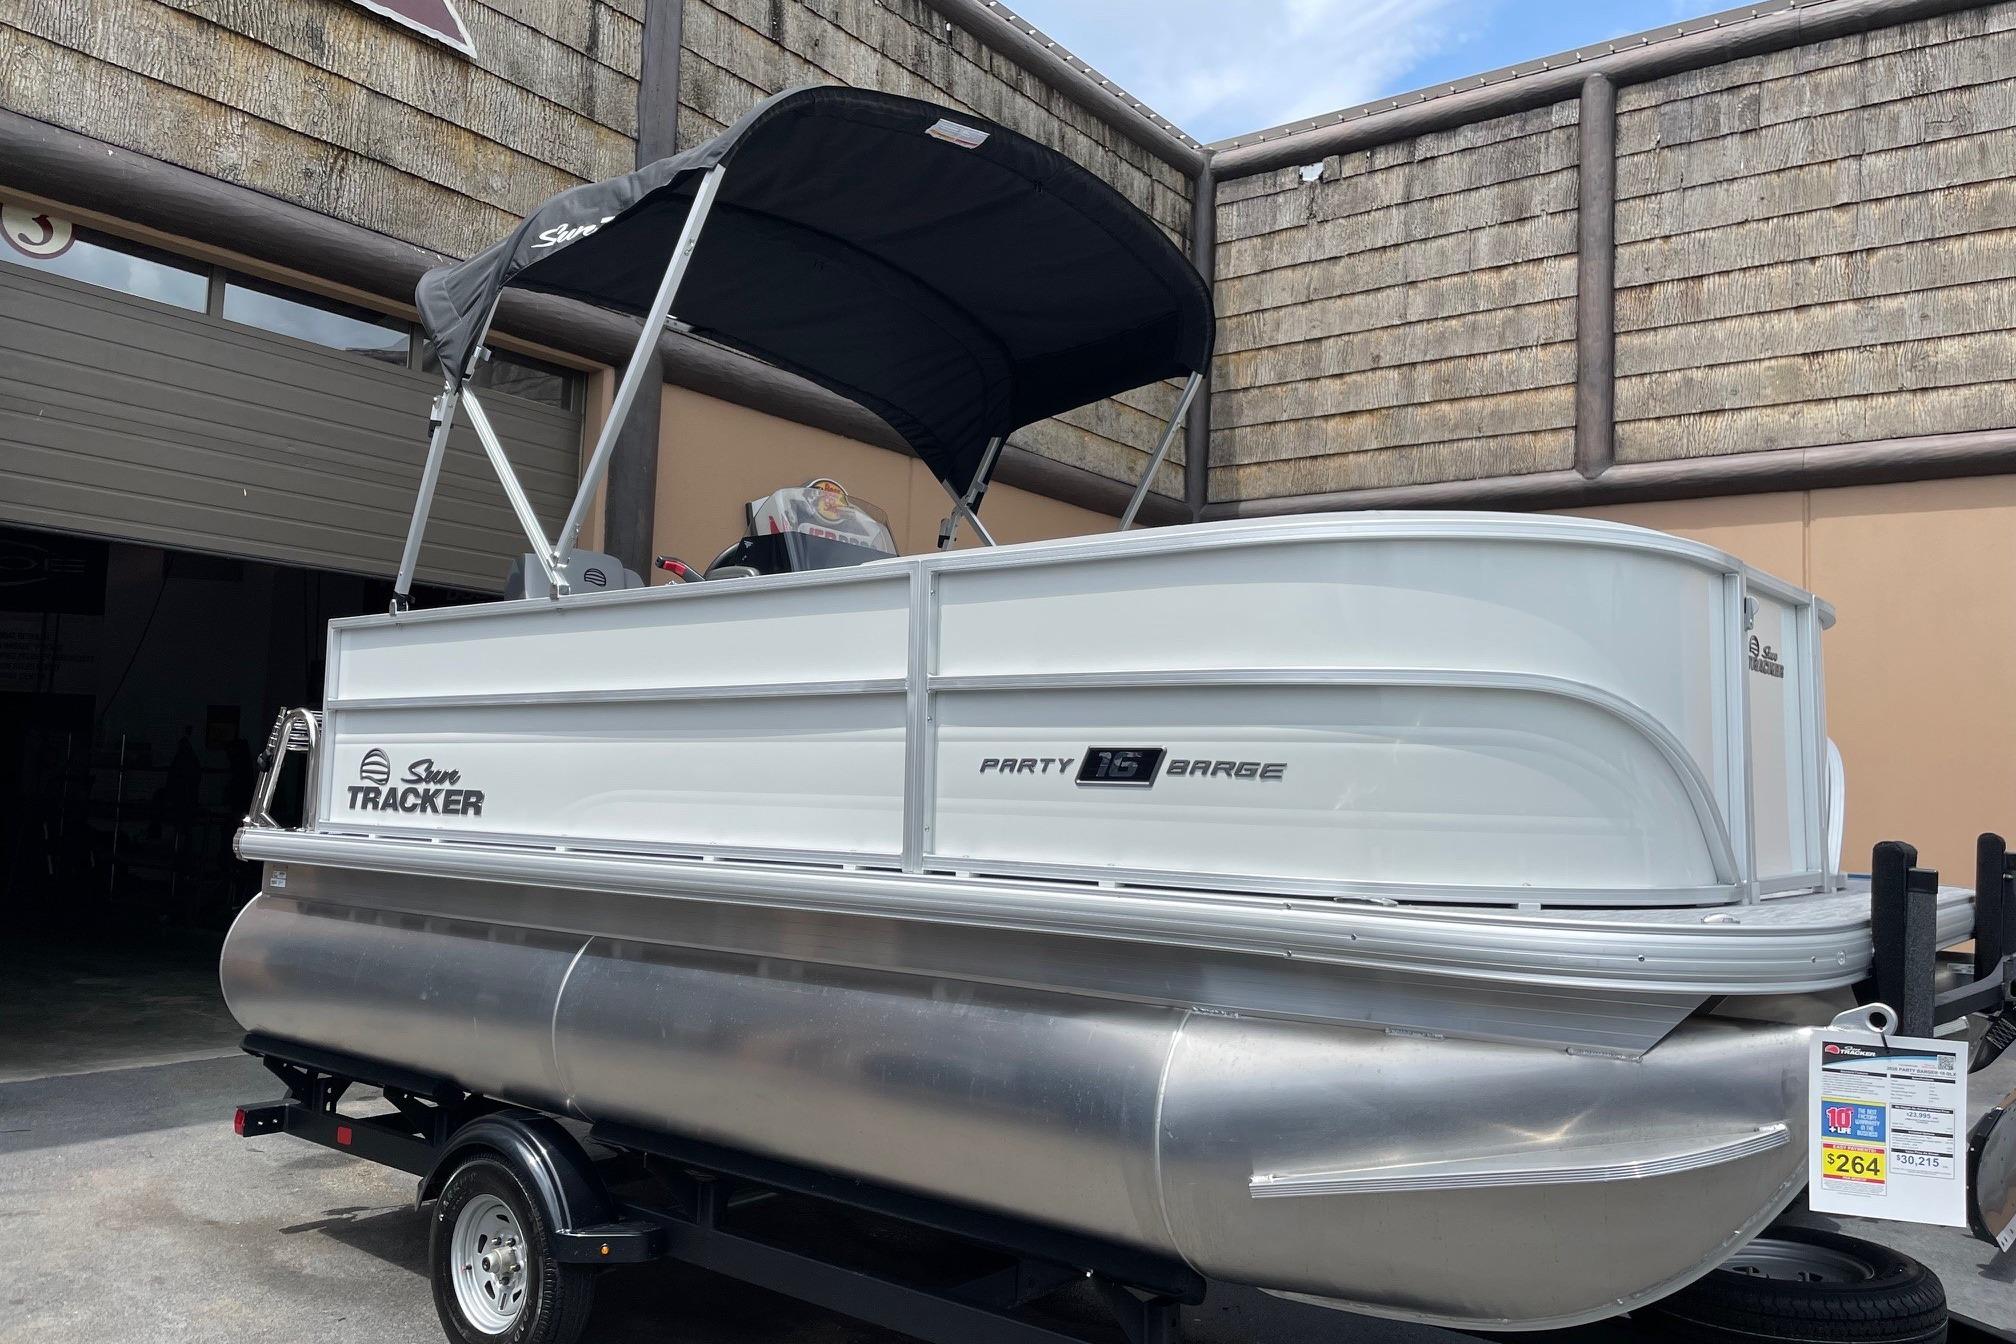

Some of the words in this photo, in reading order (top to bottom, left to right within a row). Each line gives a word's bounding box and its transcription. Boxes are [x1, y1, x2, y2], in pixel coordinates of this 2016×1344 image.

[530, 223, 598, 249] Sun
[1761, 645, 1778, 661] Sun
[400, 758, 462, 785] Sun
[979, 757, 1075, 775] PARTY
[1095, 751, 1144, 777] 16
[1165, 758, 1288, 780] BARGE
[347, 785, 485, 816] TRACKER
[1840, 1049, 1876, 1057] TRACKER
[1837, 1127, 1852, 1135] LIFE
[1827, 1153, 1880, 1176] $264
[1896, 1154, 1939, 1168] $30,215
